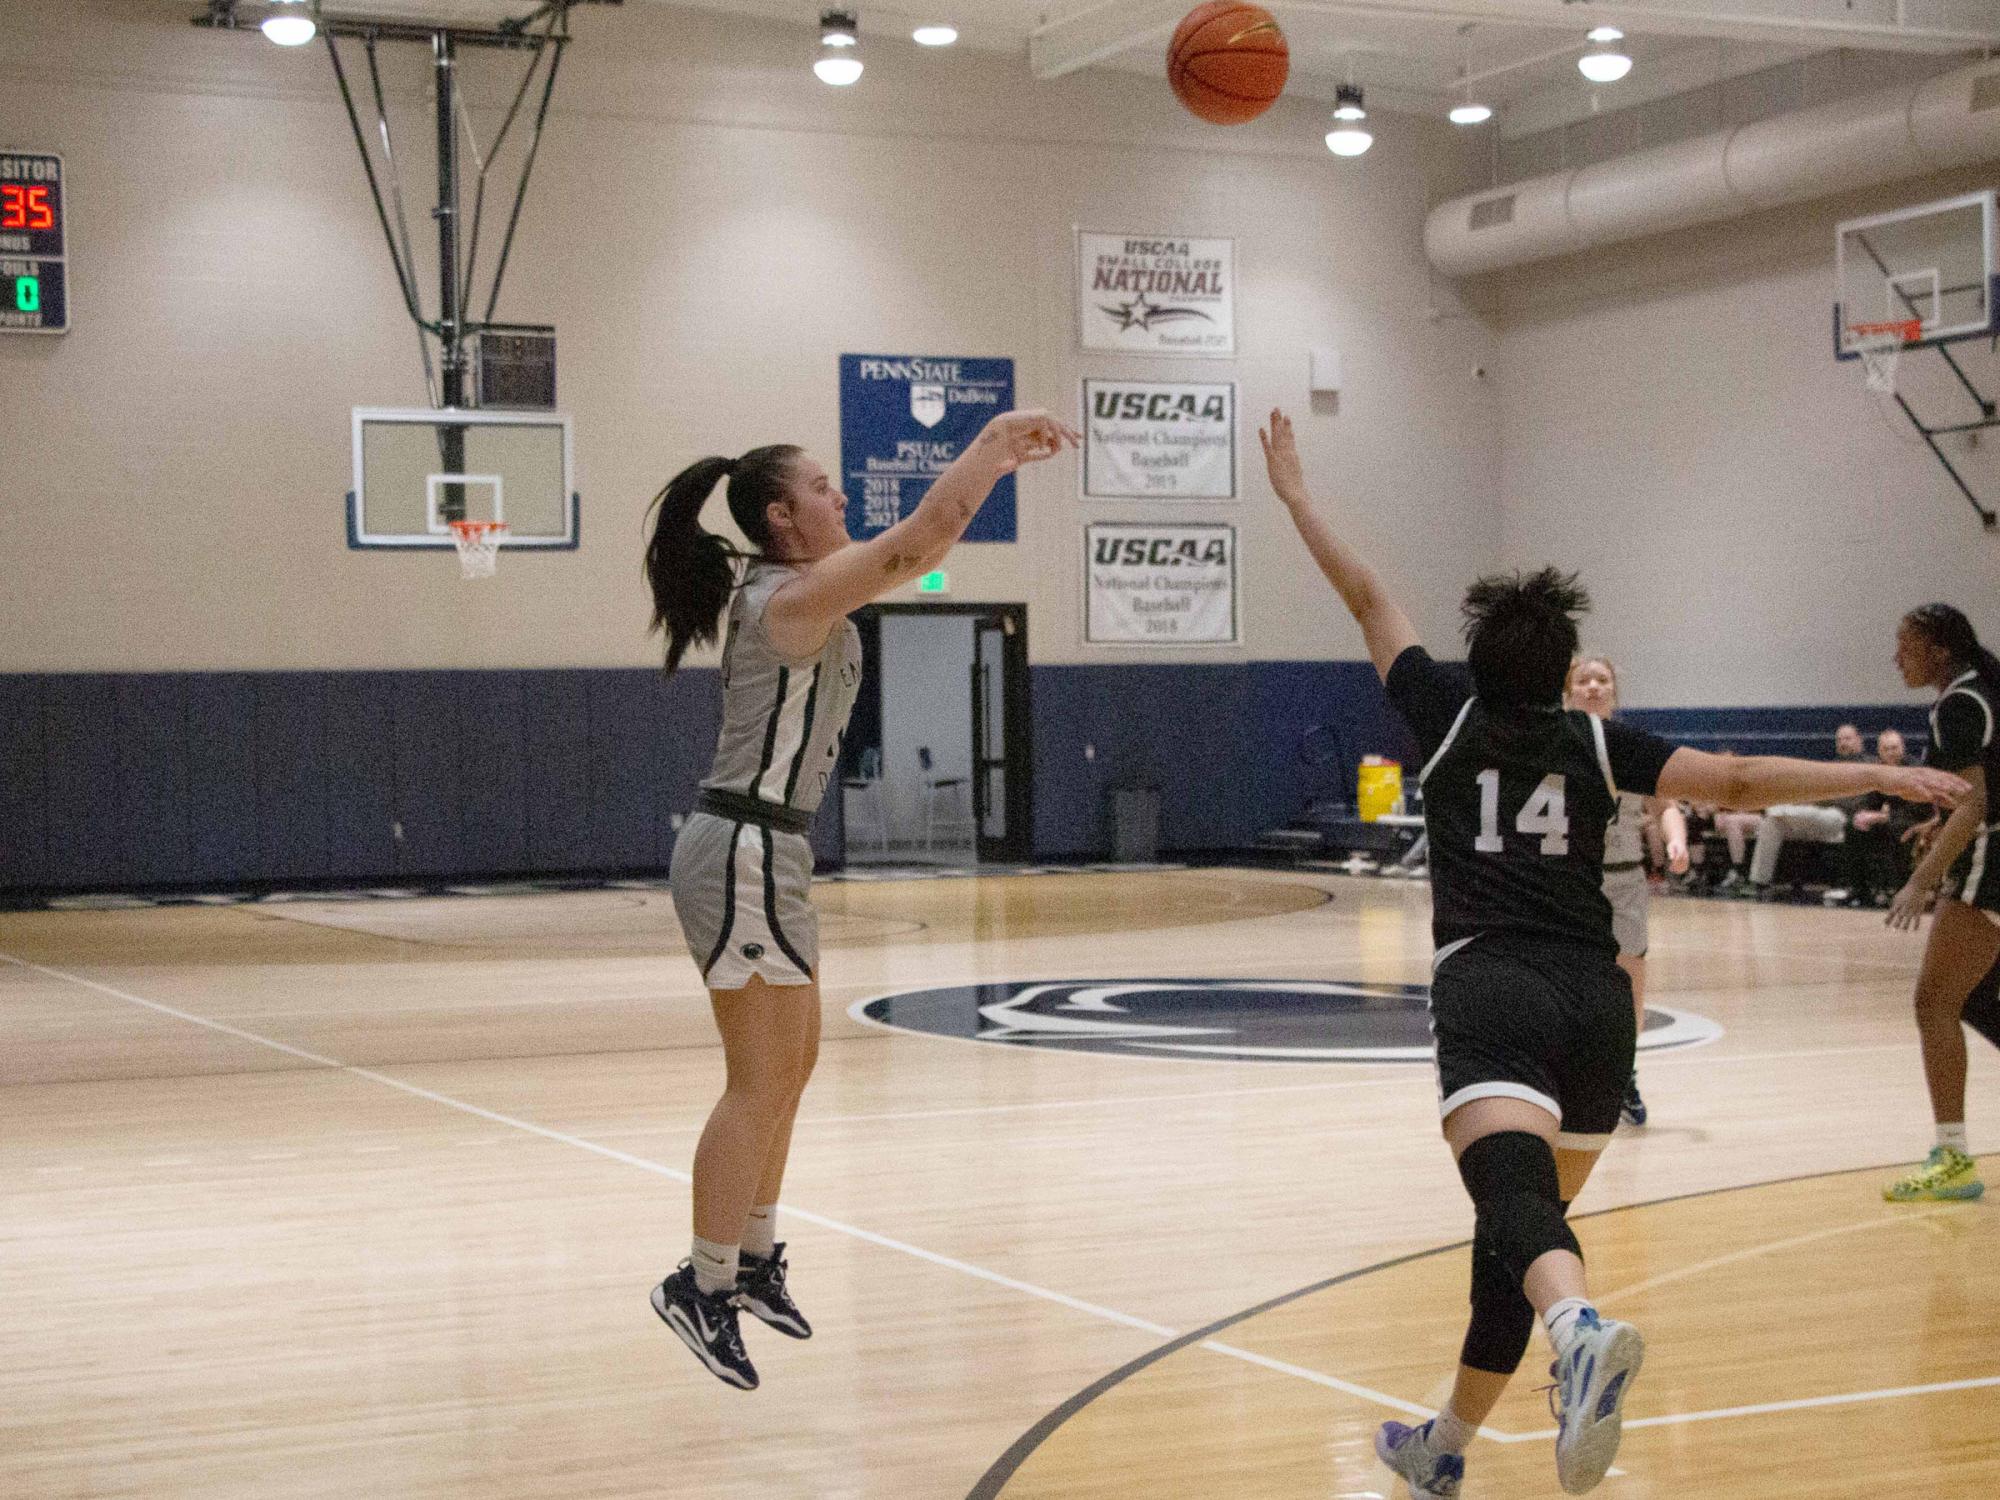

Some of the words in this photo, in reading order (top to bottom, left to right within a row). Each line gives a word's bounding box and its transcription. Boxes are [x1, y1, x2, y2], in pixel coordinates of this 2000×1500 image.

[0, 160, 58, 181] SITOR
[1, 185, 54, 229] 35
[1124, 240, 1190, 256] USCAA
[1097, 255, 1147, 269] SMALL
[1154, 257, 1222, 270] COLLEGE
[1093, 268, 1223, 294] NATIONAL
[16, 275, 40, 311] 0
[1094, 391, 1225, 422] USCAA
[1093, 428, 1149, 445] National
[896, 441, 955, 459] PSUAC
[1131, 451, 1189, 467] Baseball
[1095, 537, 1227, 566] USCAA
[1093, 574, 1150, 589] National
[1133, 596, 1191, 612] Baseball
[1474, 768, 1569, 855] 14
